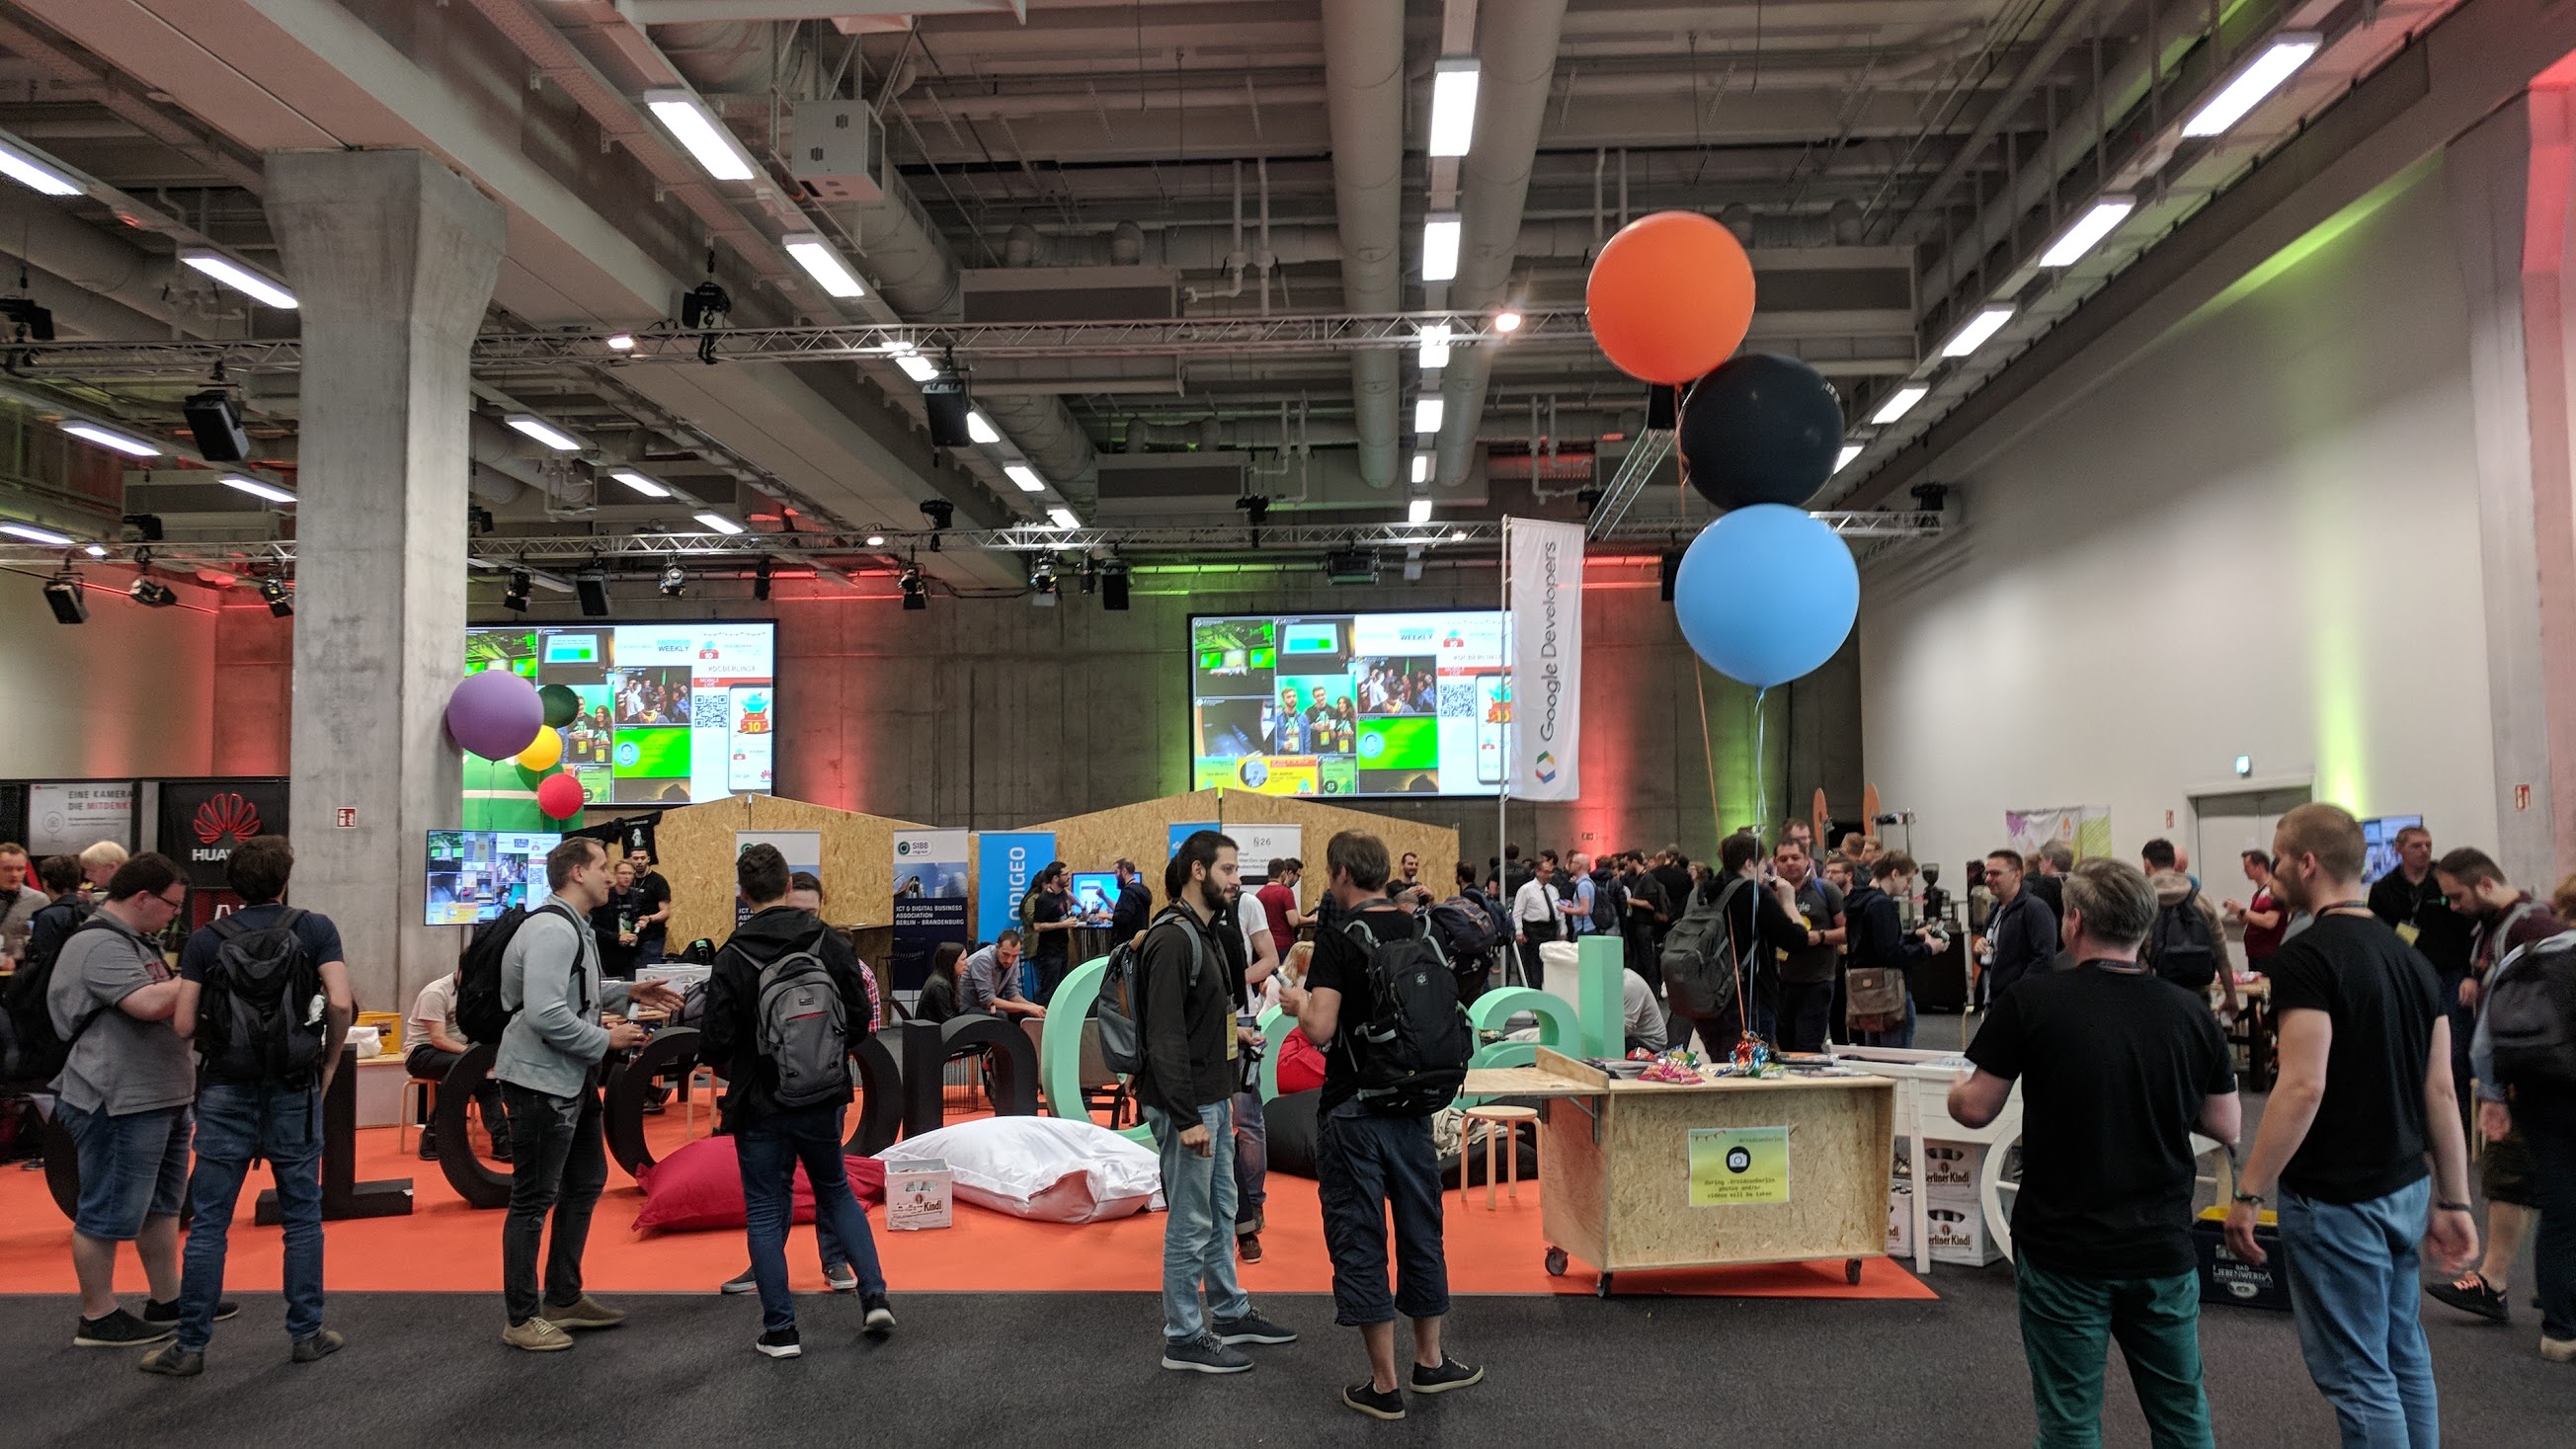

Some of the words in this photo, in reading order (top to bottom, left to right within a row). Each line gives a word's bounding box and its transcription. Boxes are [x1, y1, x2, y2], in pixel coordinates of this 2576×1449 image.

[1541, 541, 1561, 658] Developers
[1540, 665, 1562, 742] Google
[748, 721, 762, 733] 10
[68, 790, 89, 799] EINE
[86, 801, 132, 810] MITDENK
[1253, 837, 1271, 847] N26
[192, 848, 232, 861] HUA
[1008, 845, 1026, 921] ODIGEO
[1925, 1171, 1950, 1183] erliner
[1950, 1171, 1970, 1183] Kindl
[924, 1199, 942, 1212] Kindl
[1928, 1235, 1951, 1245] erliner
[1951, 1235, 1971, 1246] Kindl
[2213, 1264, 2273, 1282] LIEBENWERDA
